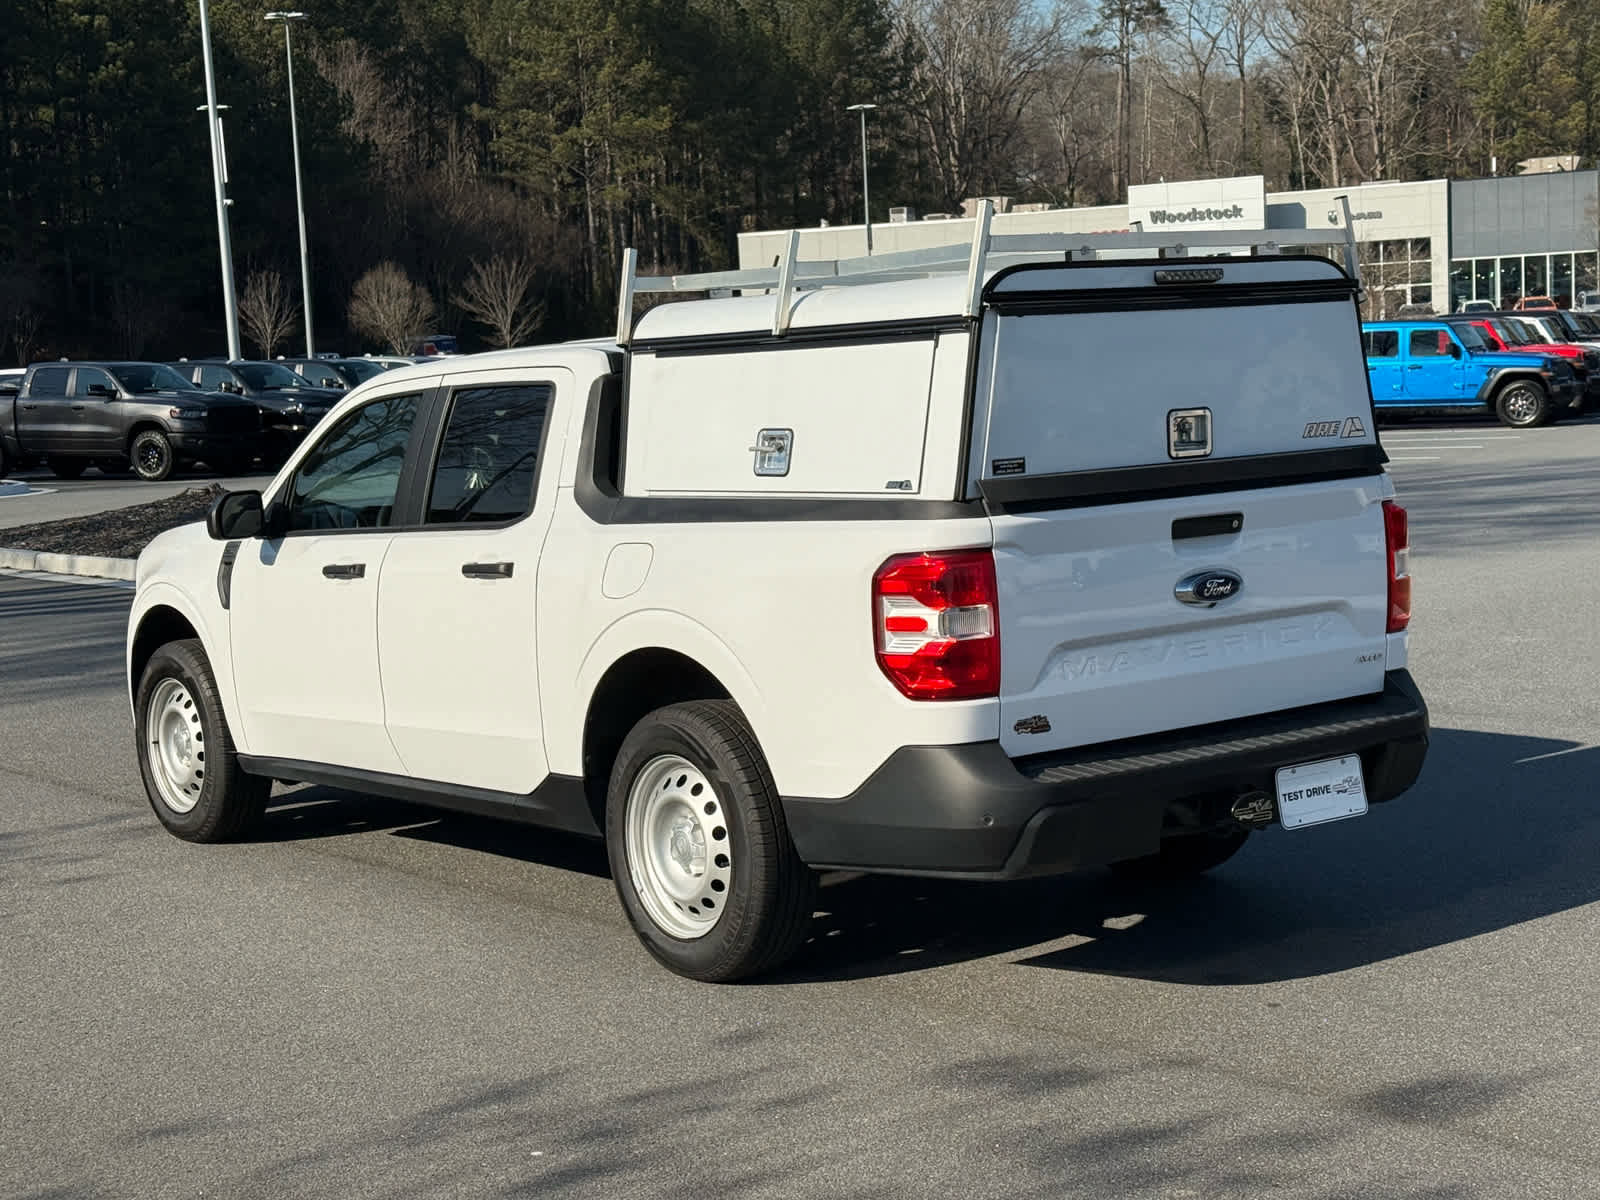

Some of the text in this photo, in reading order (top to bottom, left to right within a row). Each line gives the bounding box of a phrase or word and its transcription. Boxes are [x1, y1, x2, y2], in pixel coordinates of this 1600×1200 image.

[1149, 204, 1244, 224] Woodstock
[1204, 579, 1232, 597] Ford
[1059, 616, 1334, 681] MAVERICK
[1282, 790, 1304, 803] TEST
[1306, 785, 1332, 798] DRIVE
